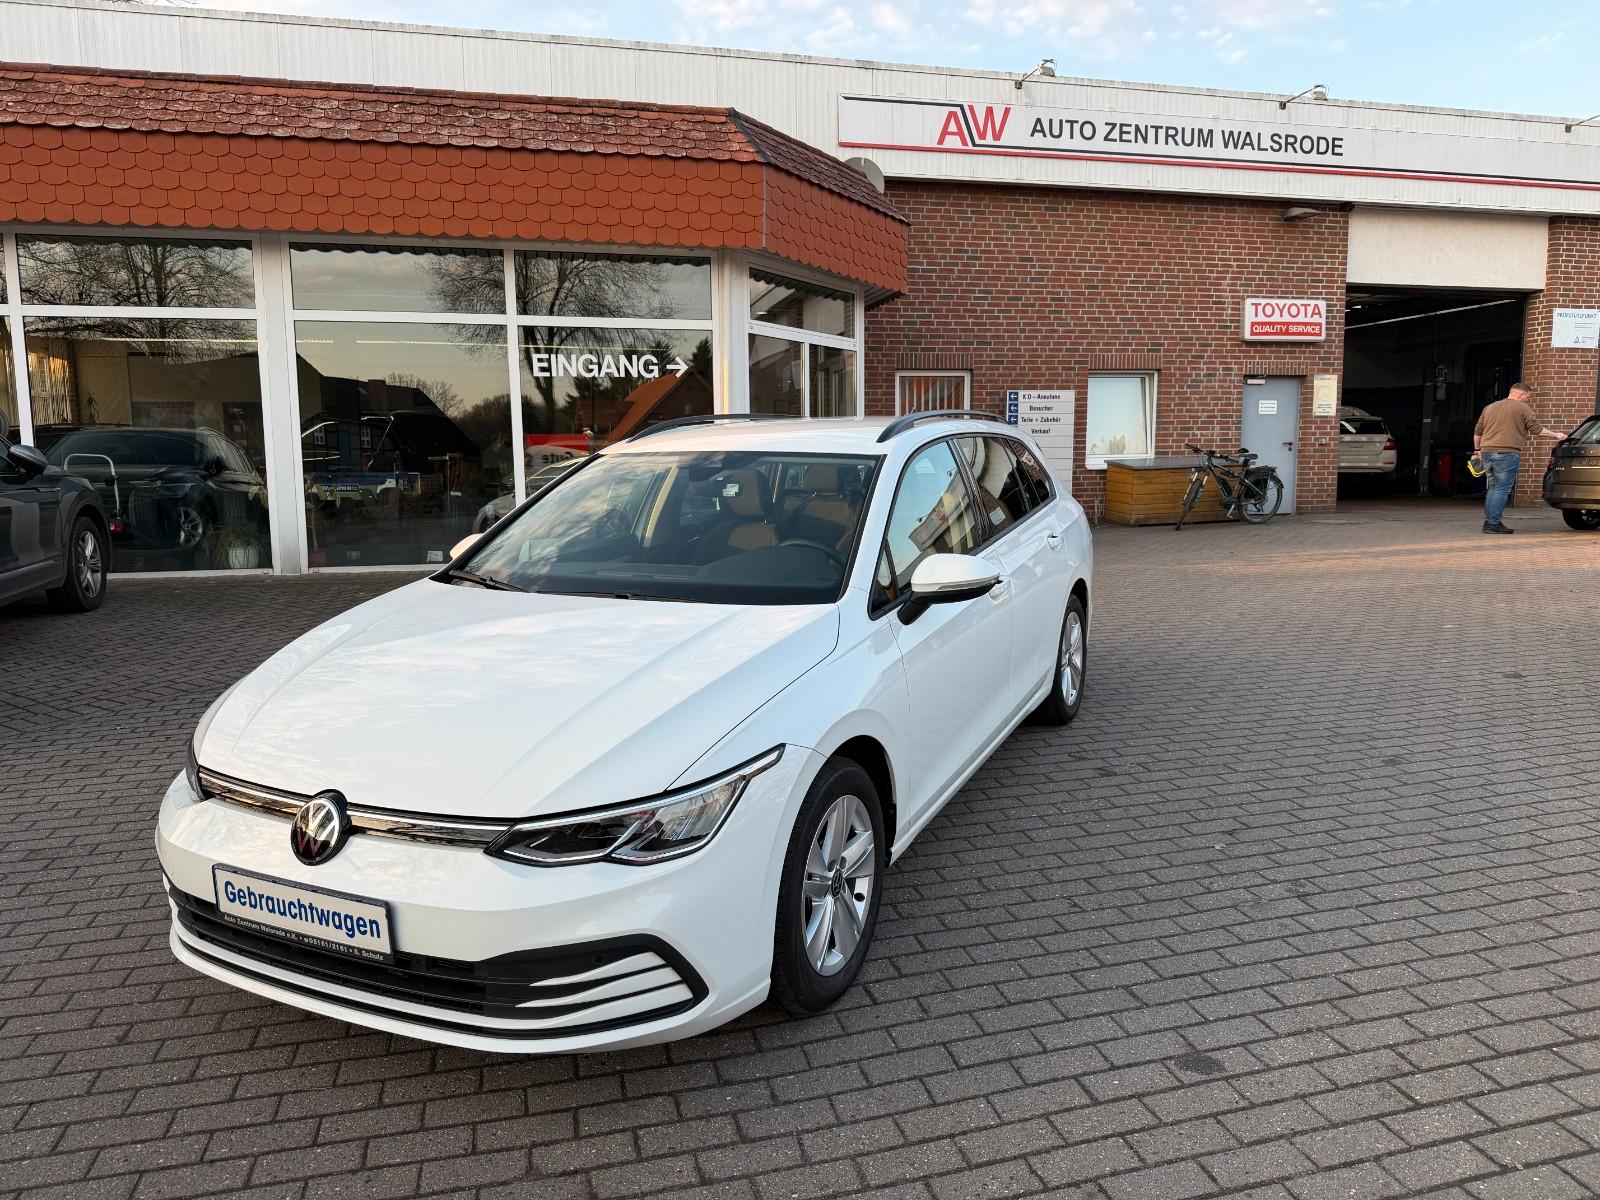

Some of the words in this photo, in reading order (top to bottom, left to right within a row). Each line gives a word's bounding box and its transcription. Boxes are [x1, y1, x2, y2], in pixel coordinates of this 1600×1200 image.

[936, 103, 1011, 148] AW
[1030, 117, 1096, 141] AUTO
[1103, 121, 1214, 150] ZENTRUM
[1221, 129, 1344, 157] WALSRODE
[1250, 302, 1323, 318] TOYOTA
[1252, 324, 1287, 333] QUALITY
[1288, 325, 1321, 334] SERVICE
[532, 353, 659, 378] EINGANG
[224, 880, 381, 939] Gebrauchtwagen
[223, 914, 236, 924] Auto
[236, 918, 260, 931] Zentrum
[260, 924, 286, 937] Walsrode
[362, 950, 384, 961] Schulz
